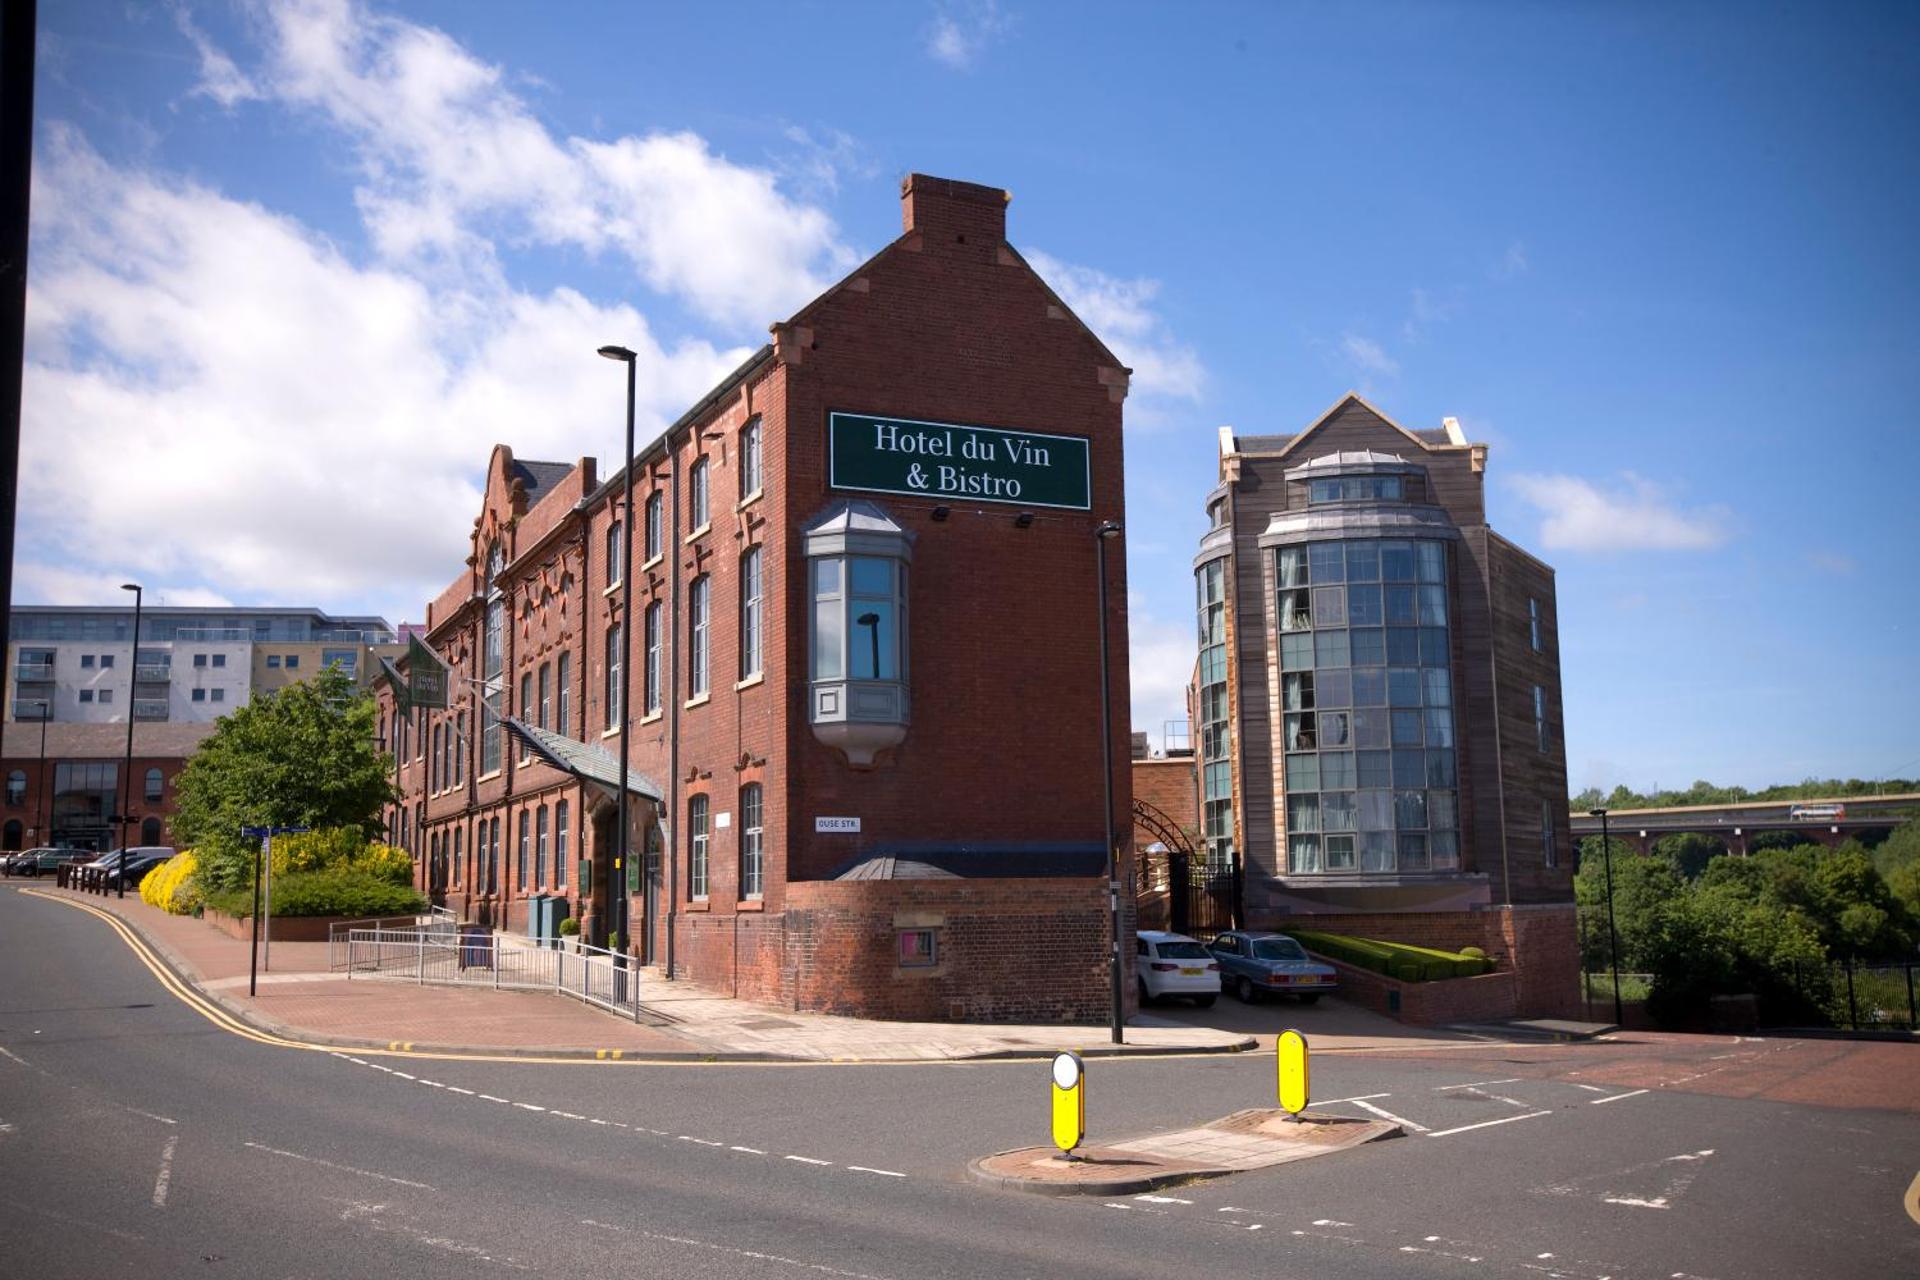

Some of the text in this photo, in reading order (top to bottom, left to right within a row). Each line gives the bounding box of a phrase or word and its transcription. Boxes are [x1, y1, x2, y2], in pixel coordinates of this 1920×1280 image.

[874, 424, 1051, 467] Hotel du Vin
[906, 462, 1021, 498] & Bistro
[818, 819, 840, 828] OUSE
